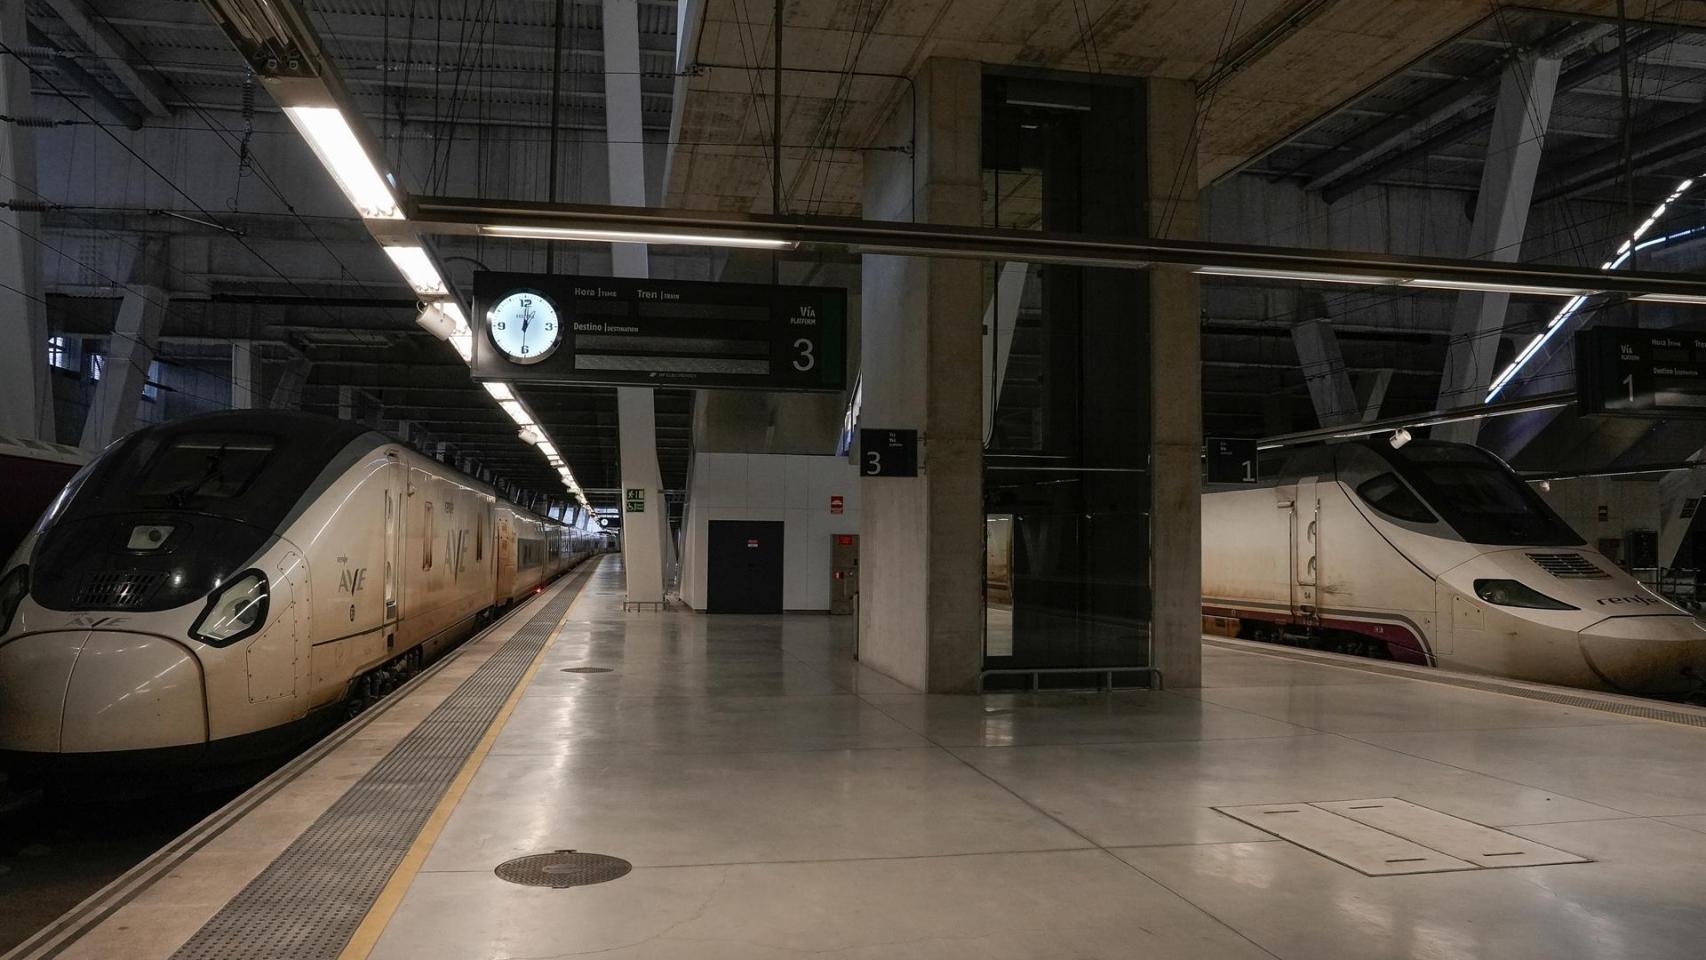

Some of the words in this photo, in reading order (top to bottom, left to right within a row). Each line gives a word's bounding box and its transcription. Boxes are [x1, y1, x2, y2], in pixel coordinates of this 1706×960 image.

[574, 287, 596, 297] Hora
[637, 289, 658, 299] Tren
[520, 299, 532, 308] 12
[497, 321, 506, 330] 9
[544, 322, 554, 331] 3
[573, 321, 602, 331] Destino
[521, 345, 529, 354] 6
[792, 338, 815, 372] 3
[1622, 374, 1634, 402] 1
[866, 450, 881, 475] 3
[1241, 459, 1256, 482] 1
[442, 529, 469, 584] AVE
[338, 567, 367, 596] AVE
[64, 616, 132, 628] AVE
